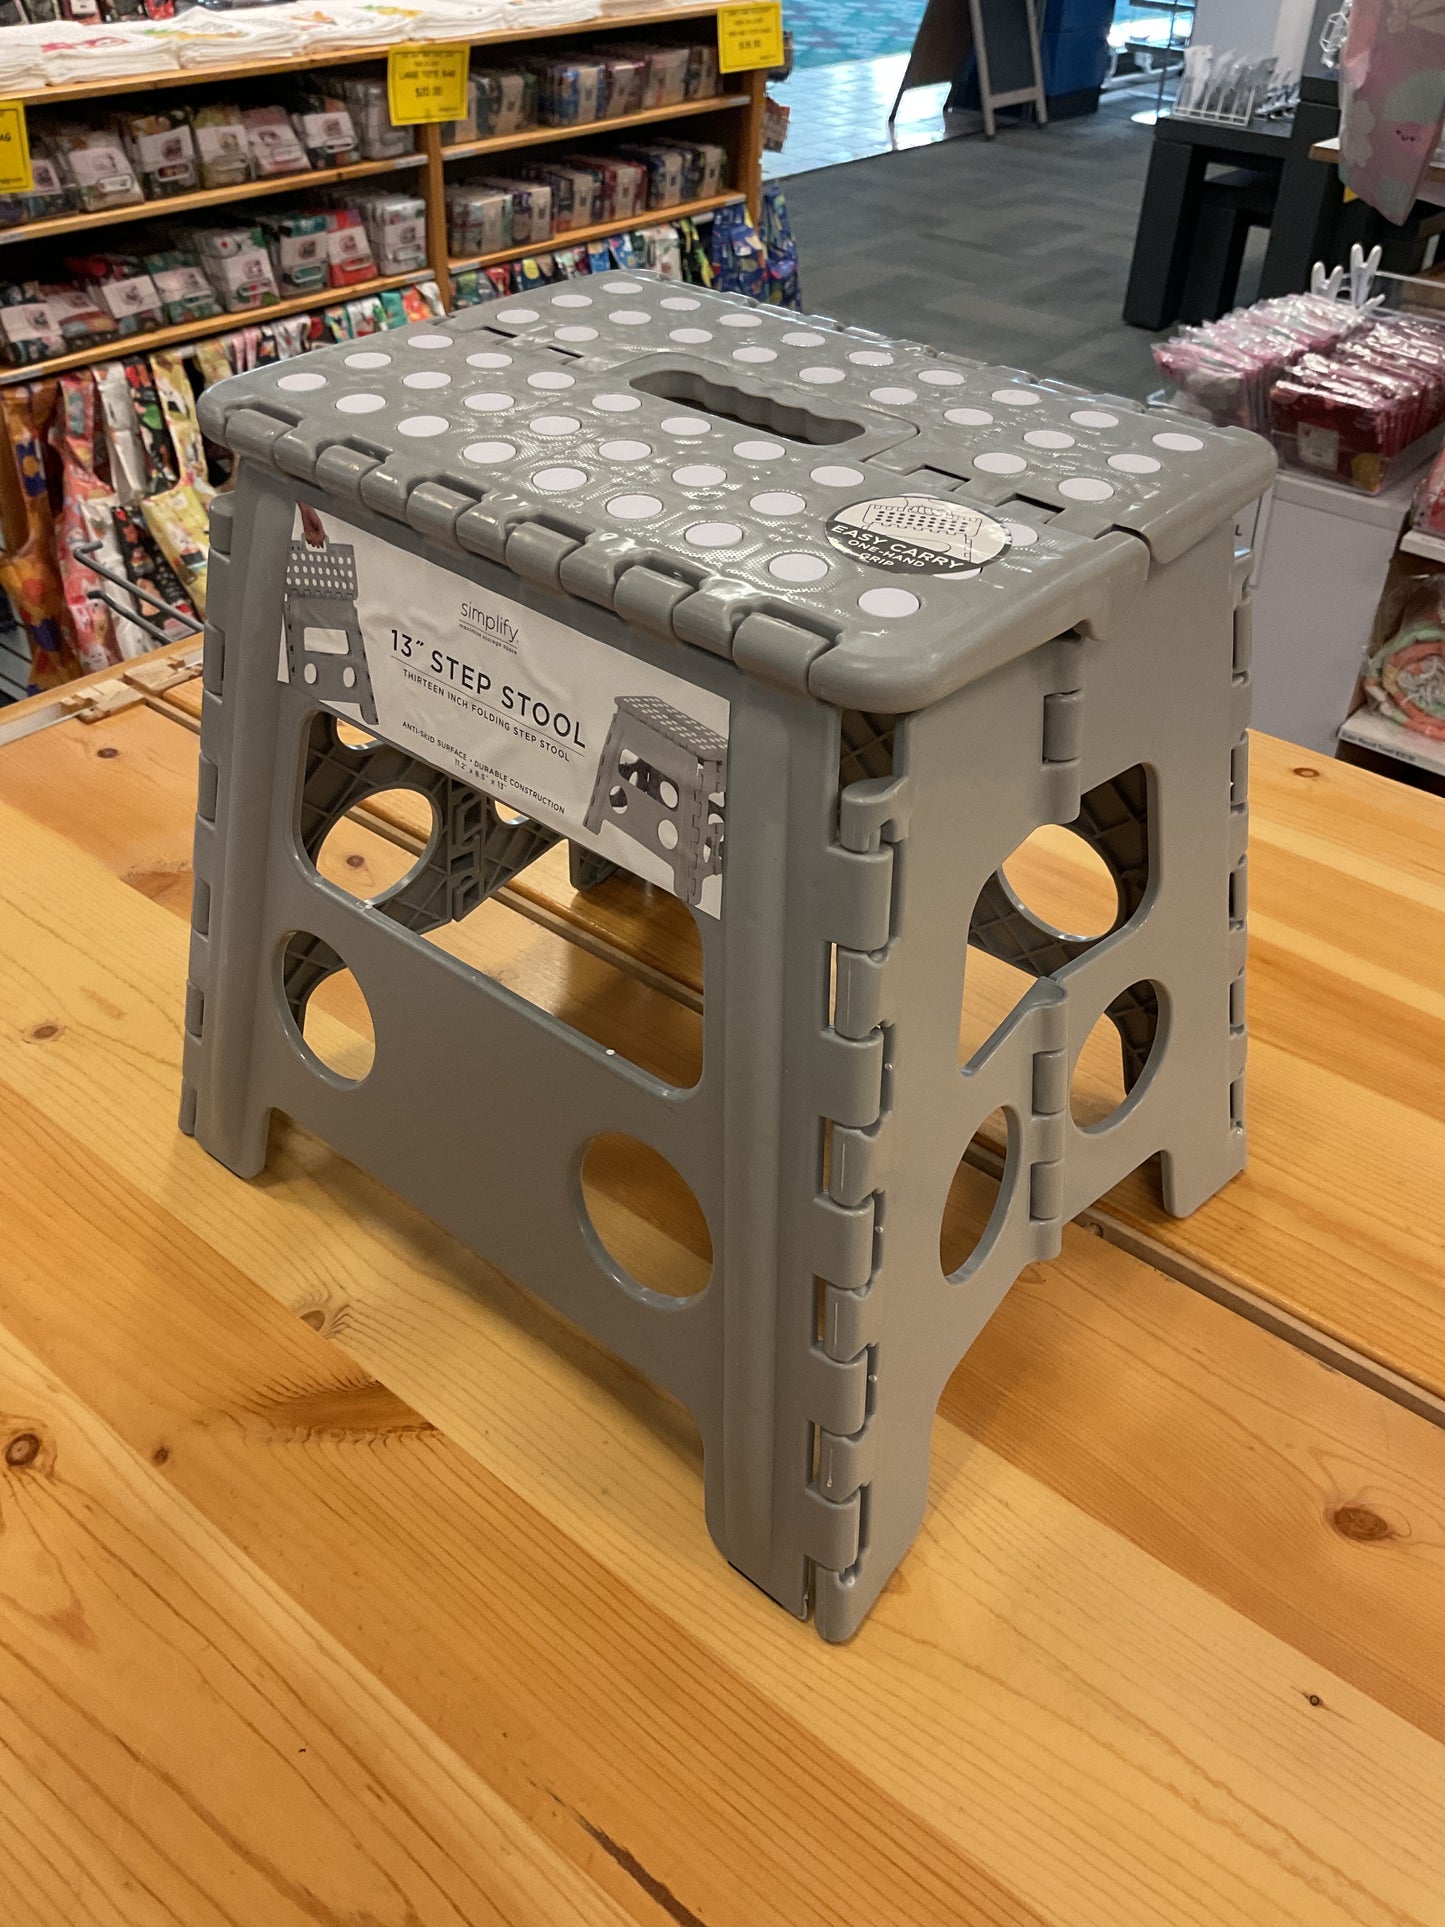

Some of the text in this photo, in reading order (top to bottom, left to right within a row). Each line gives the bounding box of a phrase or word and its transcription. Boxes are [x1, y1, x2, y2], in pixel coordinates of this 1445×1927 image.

[830, 523, 964, 569] EASY CARRY
[847, 538, 925, 567] ONE-HAND
[860, 551, 895, 567] GRIP
[460, 601, 519, 643] simplify
[391, 629, 586, 749] 13" STEP STOOL
[403, 668, 570, 762] THIRTEEN INCH FOLDING STEP STOOL
[402, 721, 565, 815] ANTI-SKID SURFACE DURABLE CONSTRUCTION
